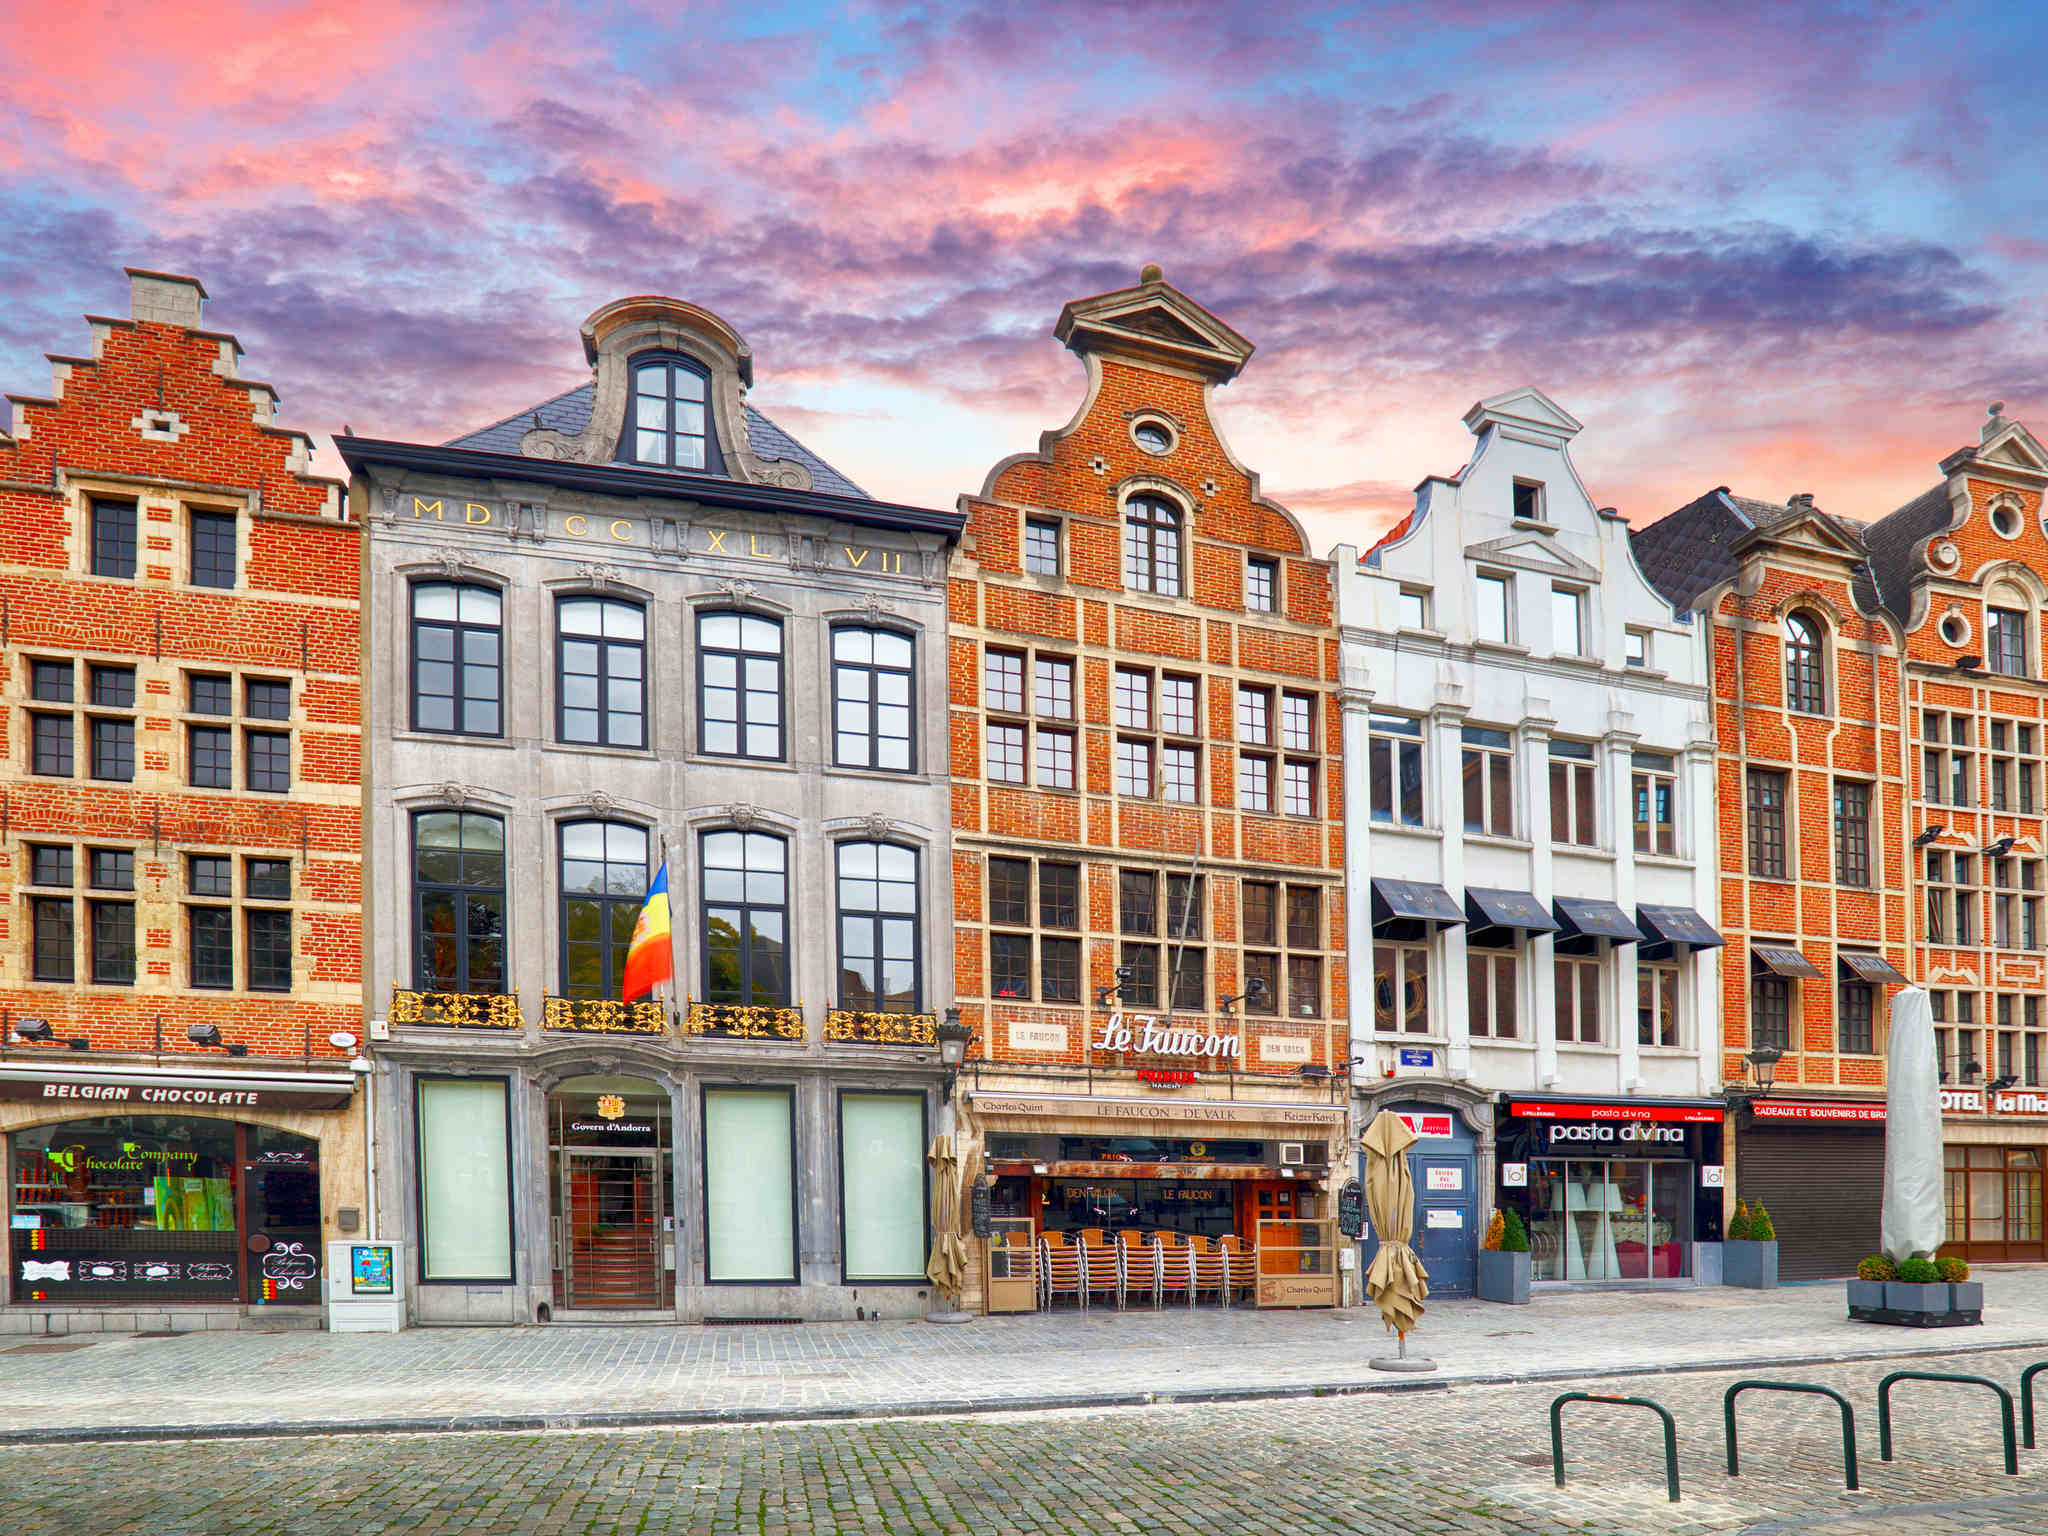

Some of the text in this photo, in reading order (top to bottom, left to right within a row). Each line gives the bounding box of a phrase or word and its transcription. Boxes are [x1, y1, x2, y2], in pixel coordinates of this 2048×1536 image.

[1015, 1031, 1061, 1042] LE FAUCON
[1092, 1013, 1241, 1057] Le Faucon
[1137, 1069, 1196, 1084] PRIMUS
[43, 1084, 259, 1105] BELGIAN CHOCOLATE
[1097, 1104, 1236, 1121] LE FAUCON DE VALK
[1592, 1109, 1620, 1118] pasta
[1753, 1107, 1795, 1117] CADEAUX
[1796, 1108, 1808, 1117] ET
[1810, 1108, 1857, 1118] SOUVENIRS
[1858, 1110, 1869, 1118] DE
[571, 1122, 651, 1132] Govern d'Andorra
[1550, 1123, 1614, 1144] pasta
[62, 1144, 144, 1172] Chocolate
[127, 1144, 199, 1163] Company
[1163, 1189, 1213, 1200] LE FAUCON
